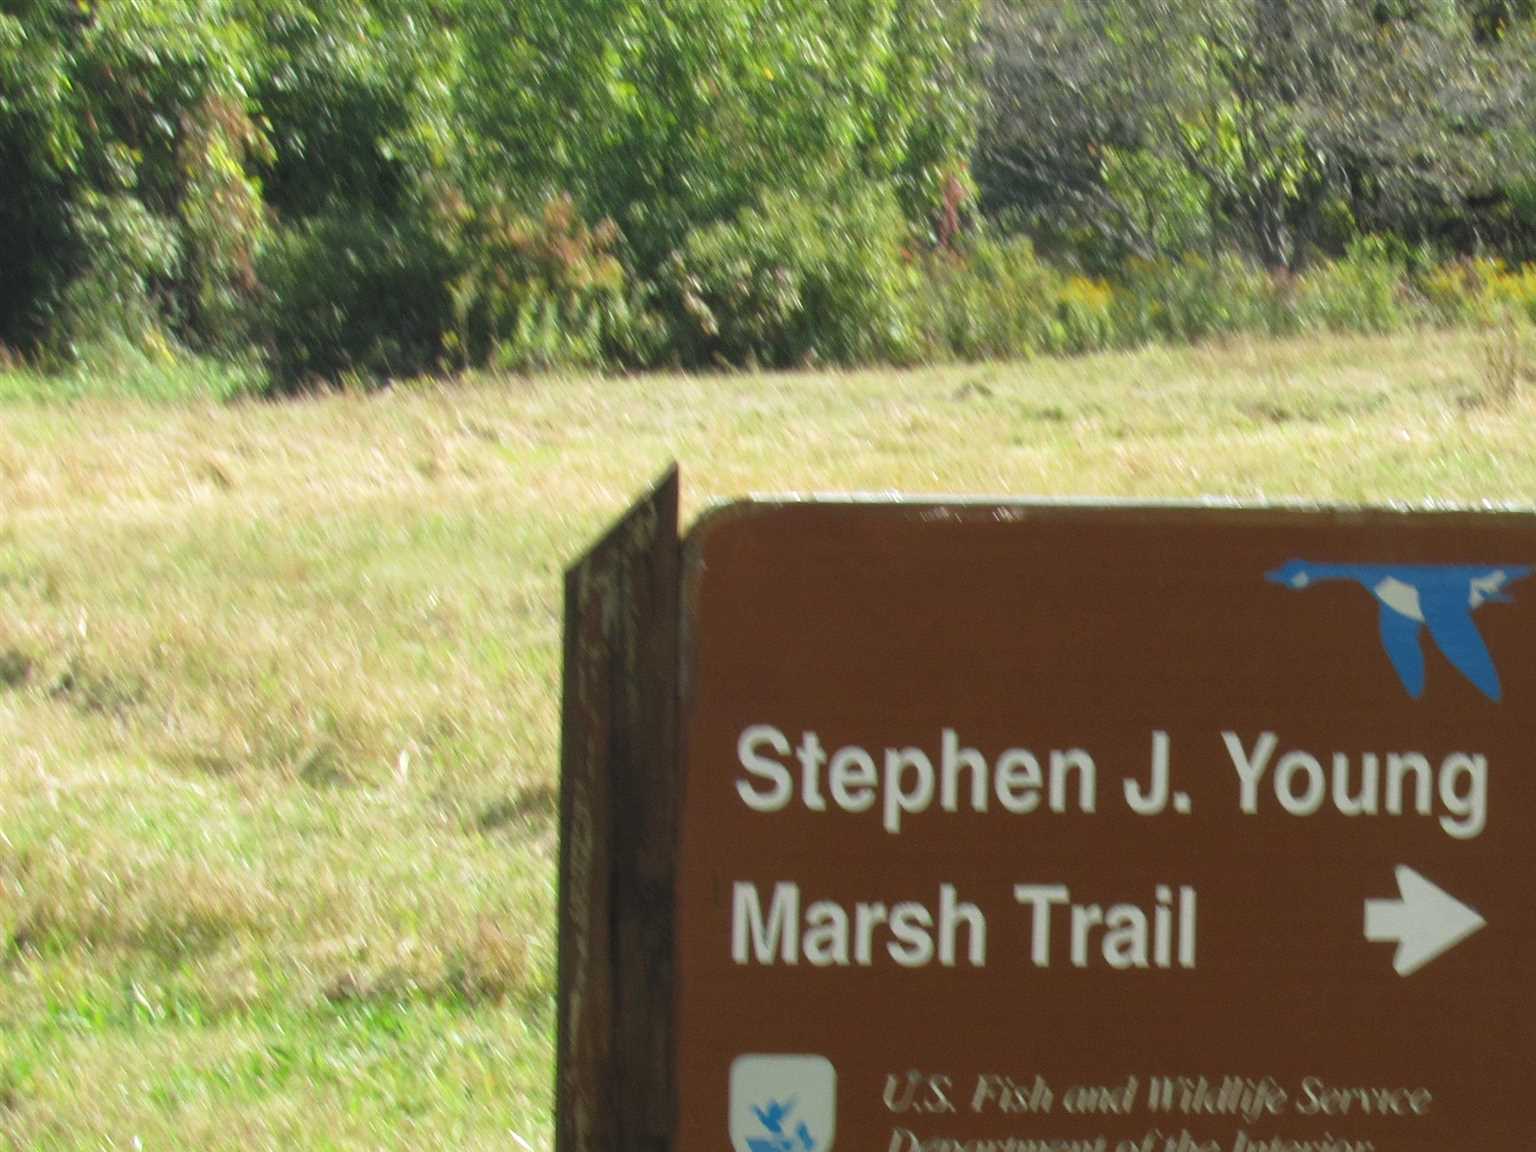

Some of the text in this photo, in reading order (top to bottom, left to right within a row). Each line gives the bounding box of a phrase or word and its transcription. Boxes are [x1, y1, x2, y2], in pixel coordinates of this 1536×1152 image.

[735, 725, 1488, 838] Stephen J. Young
[731, 882, 1197, 967] Marsh Trail
[882, 1073, 1432, 1124] U.S. Fish and Wildlife Service
